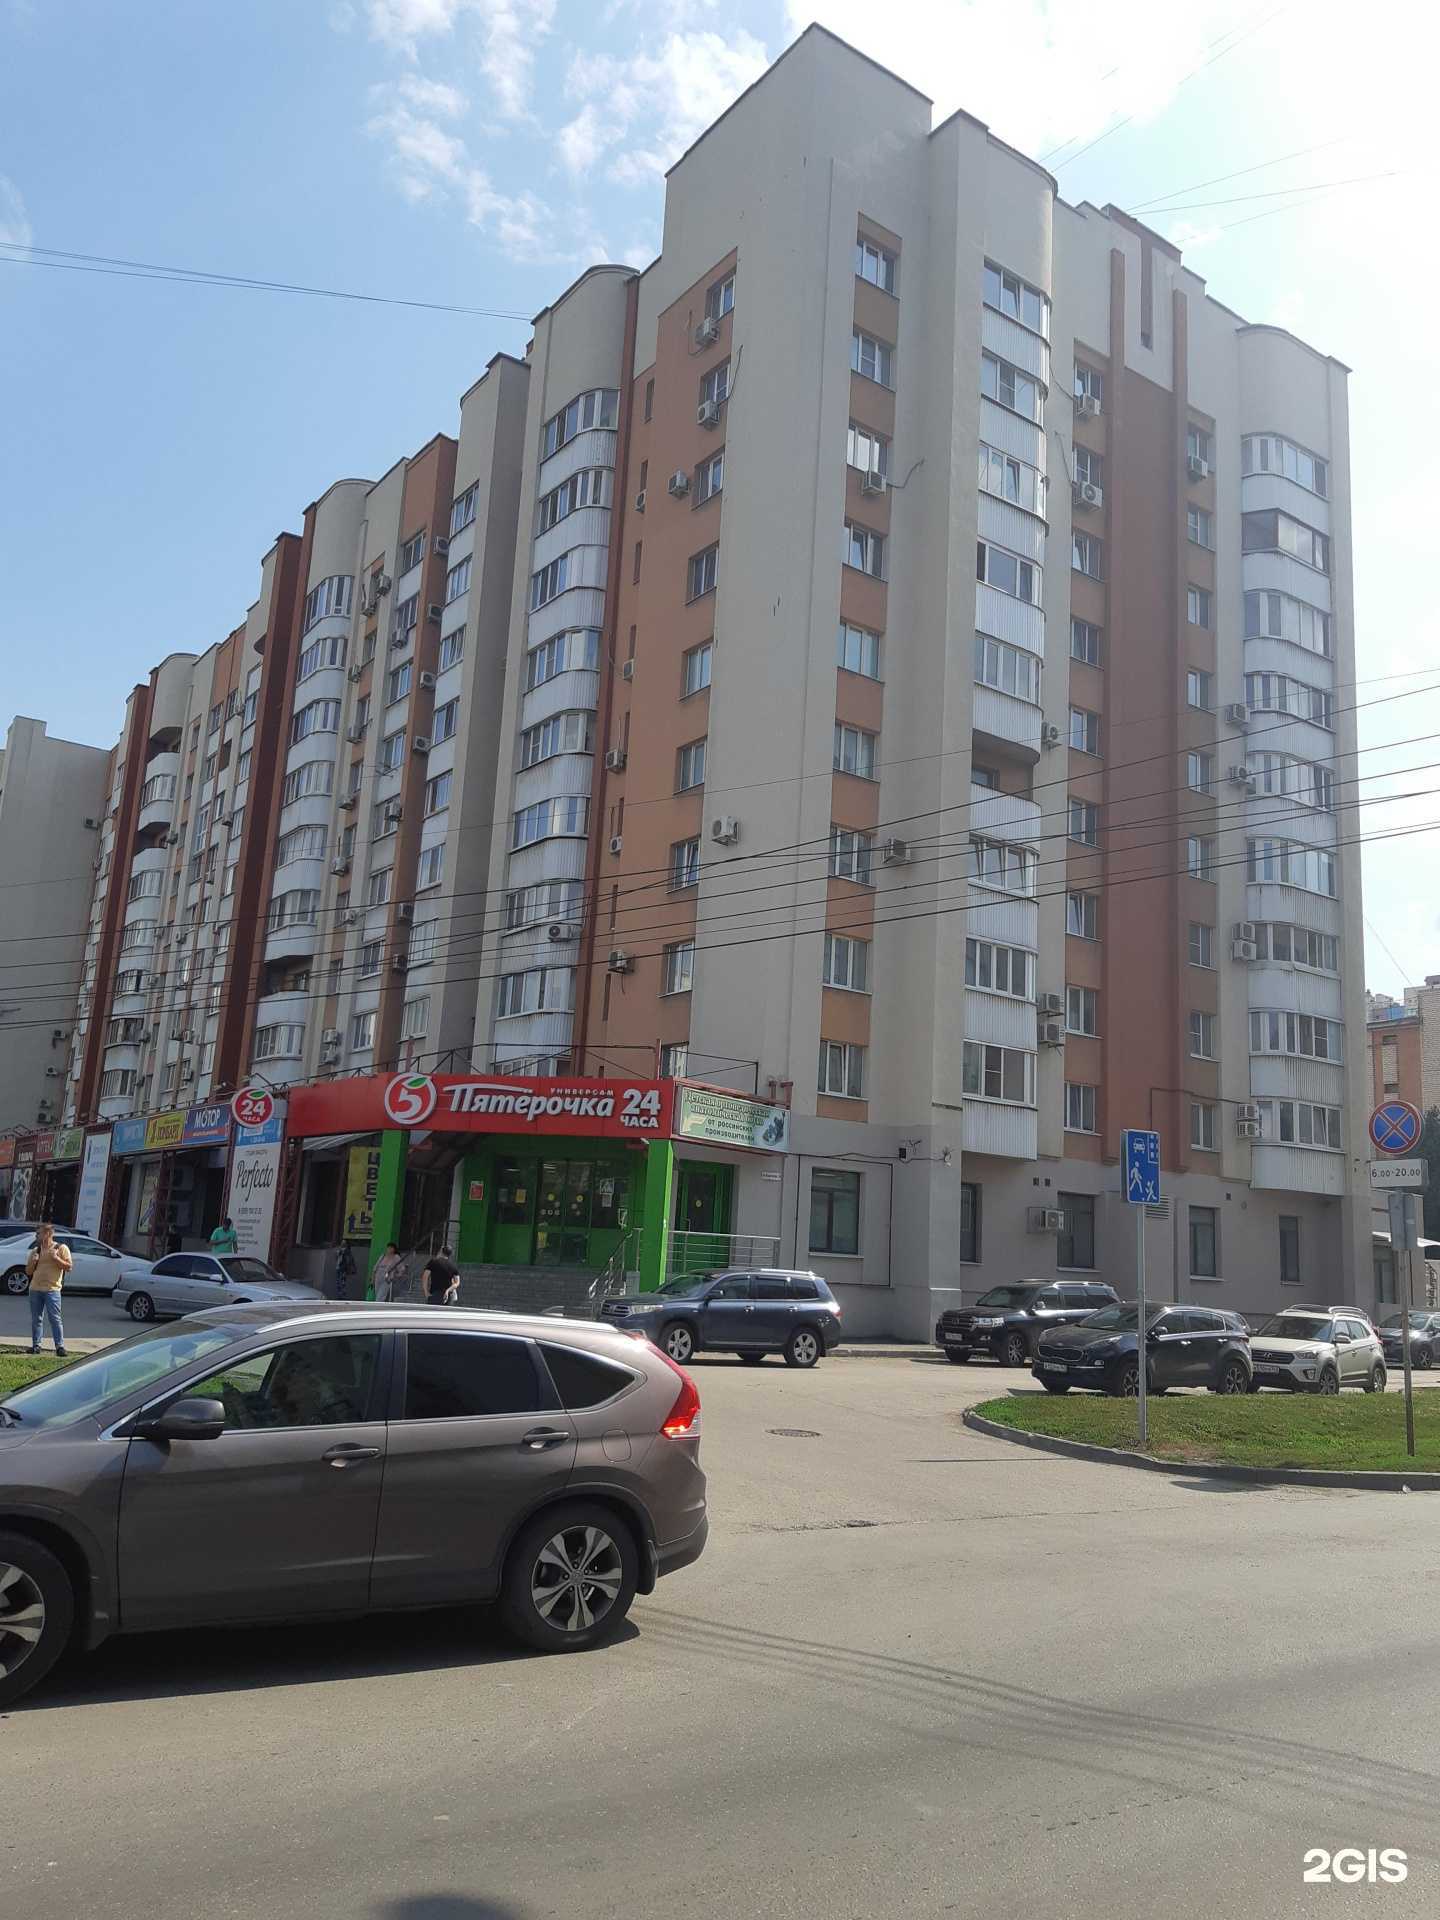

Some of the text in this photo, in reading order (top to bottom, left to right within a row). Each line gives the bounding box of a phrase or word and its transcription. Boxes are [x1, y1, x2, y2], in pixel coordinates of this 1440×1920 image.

[550, 1087, 614, 1096] УНИВЕРСАМ
[241, 1099, 266, 1117] 24
[622, 1088, 661, 1115] 24
[194, 1107, 221, 1129] МОТОР
[242, 1114, 262, 1122] ЧАСА
[620, 1115, 659, 1128] ЧАСА
[707, 1118, 716, 1126] от
[1371, 1167, 1421, 1178] 6.00-20.00
[234, 1159, 275, 1202] Perfecto
